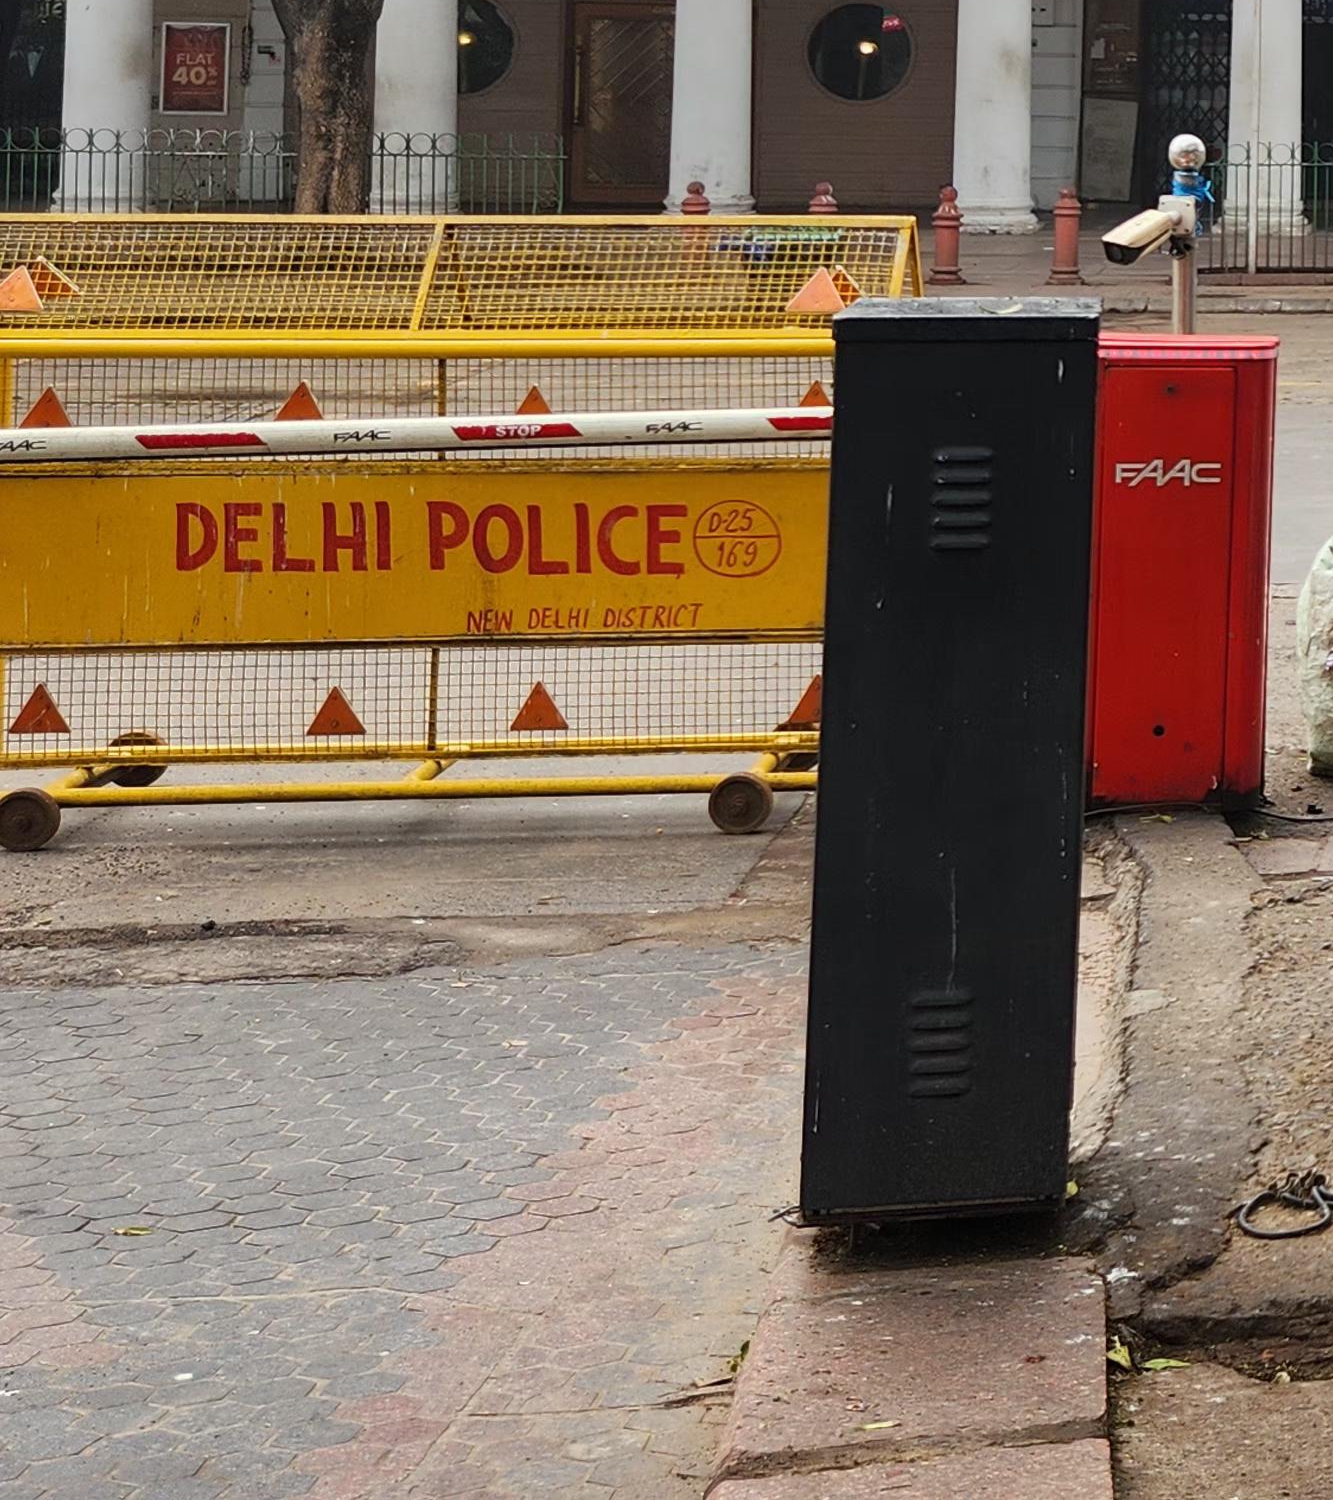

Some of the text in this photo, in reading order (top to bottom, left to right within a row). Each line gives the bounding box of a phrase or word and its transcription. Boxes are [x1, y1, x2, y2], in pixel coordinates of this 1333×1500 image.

[175, 52, 215, 65] FLAT
[333, 430, 392, 444] FAAC
[494, 423, 543, 438] STOP
[645, 421, 703, 435] FAAC
[0, 439, 48, 453] AAC
[1115, 459, 1222, 487] FAAC
[708, 508, 757, 533] D-25
[175, 500, 689, 577] DELHI POLICE
[716, 541, 758, 569] 169
[466, 602, 704, 634] NEW DELHI DISTRICT
